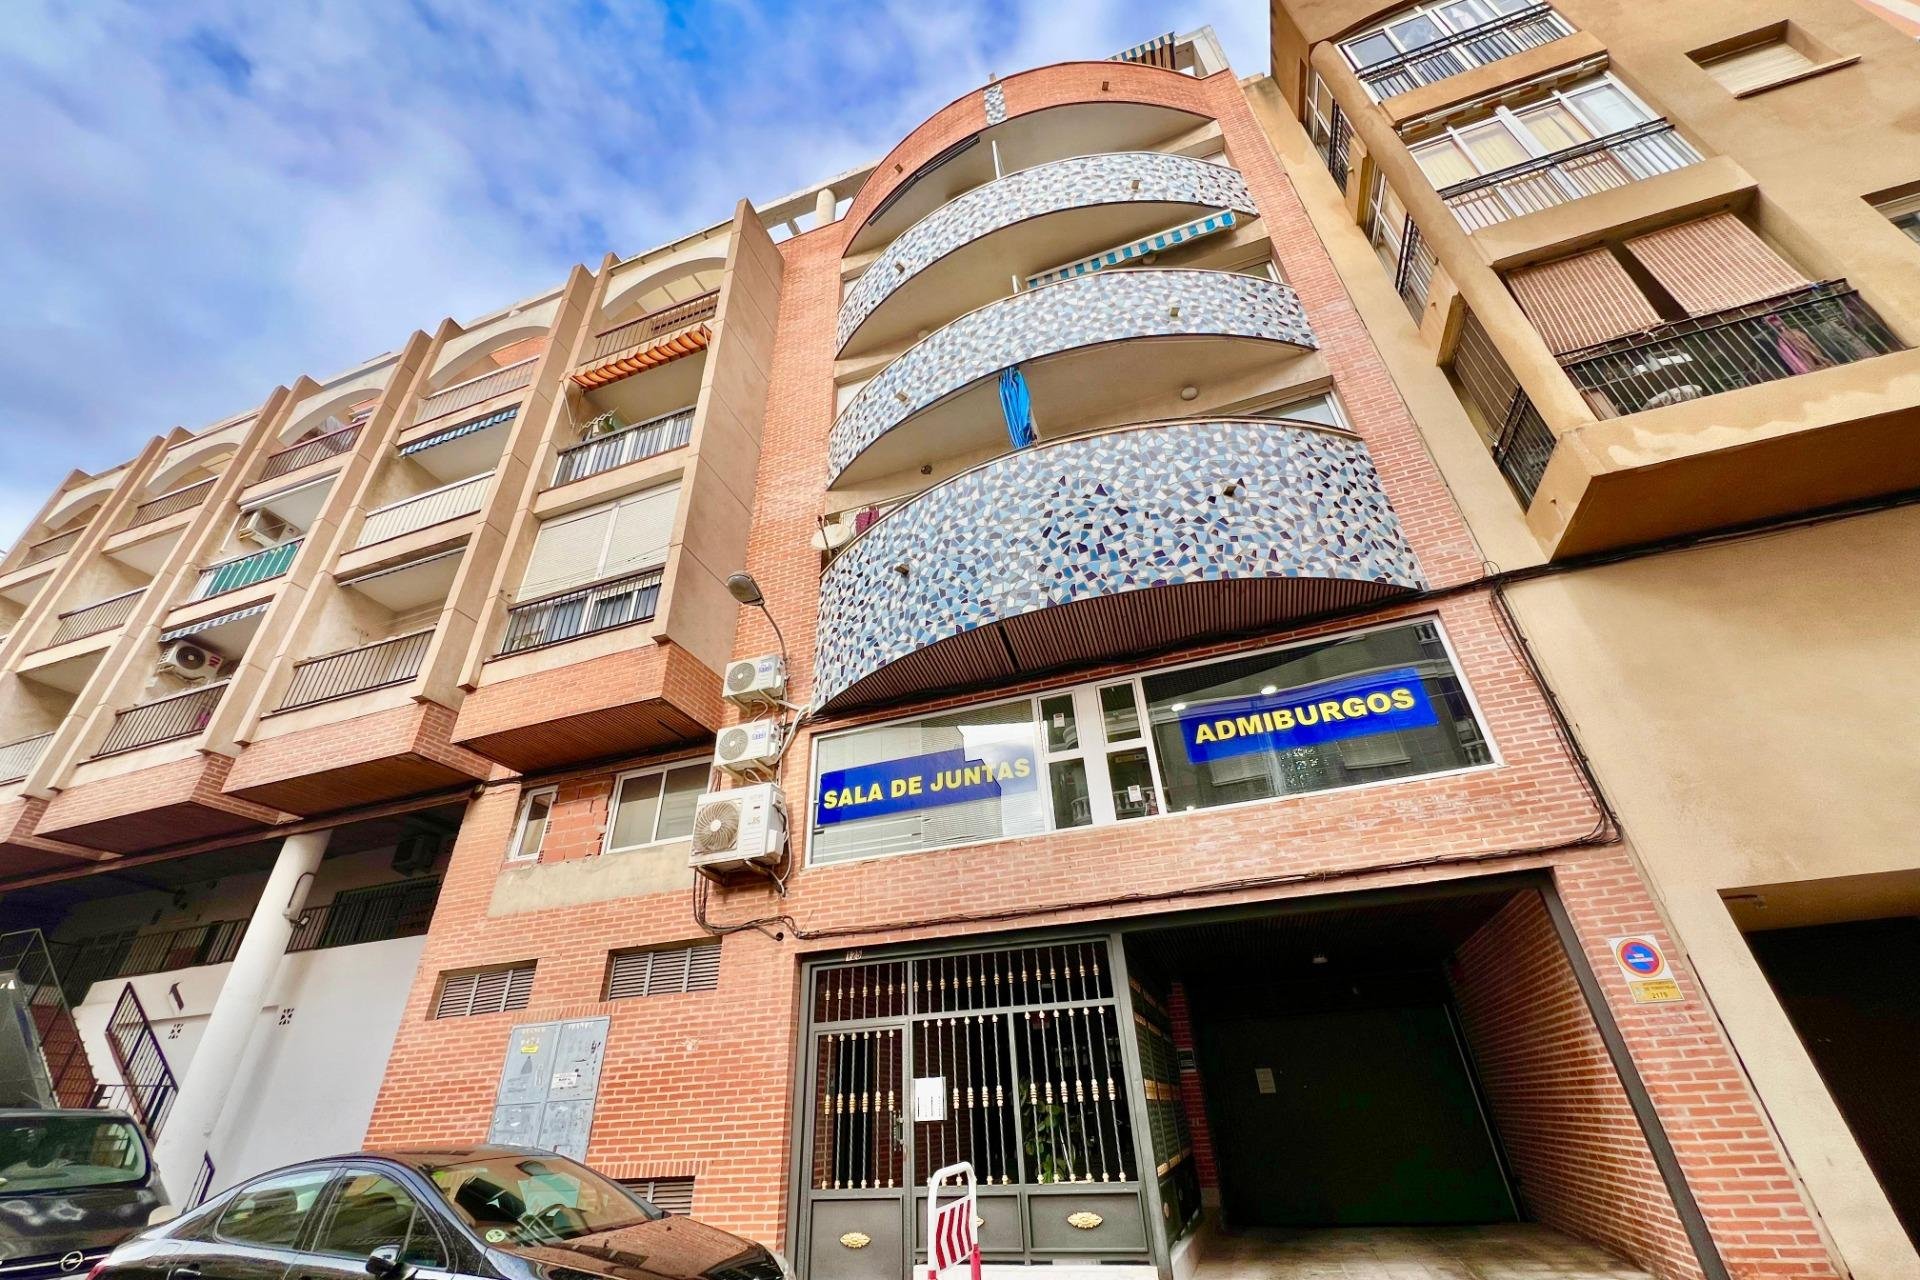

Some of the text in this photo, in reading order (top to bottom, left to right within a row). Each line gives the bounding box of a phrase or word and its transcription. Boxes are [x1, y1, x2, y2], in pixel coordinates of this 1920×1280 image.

[1195, 688, 1415, 744] ADMIBURGOS
[823, 757, 1031, 809] SALA DE JUNTAS
